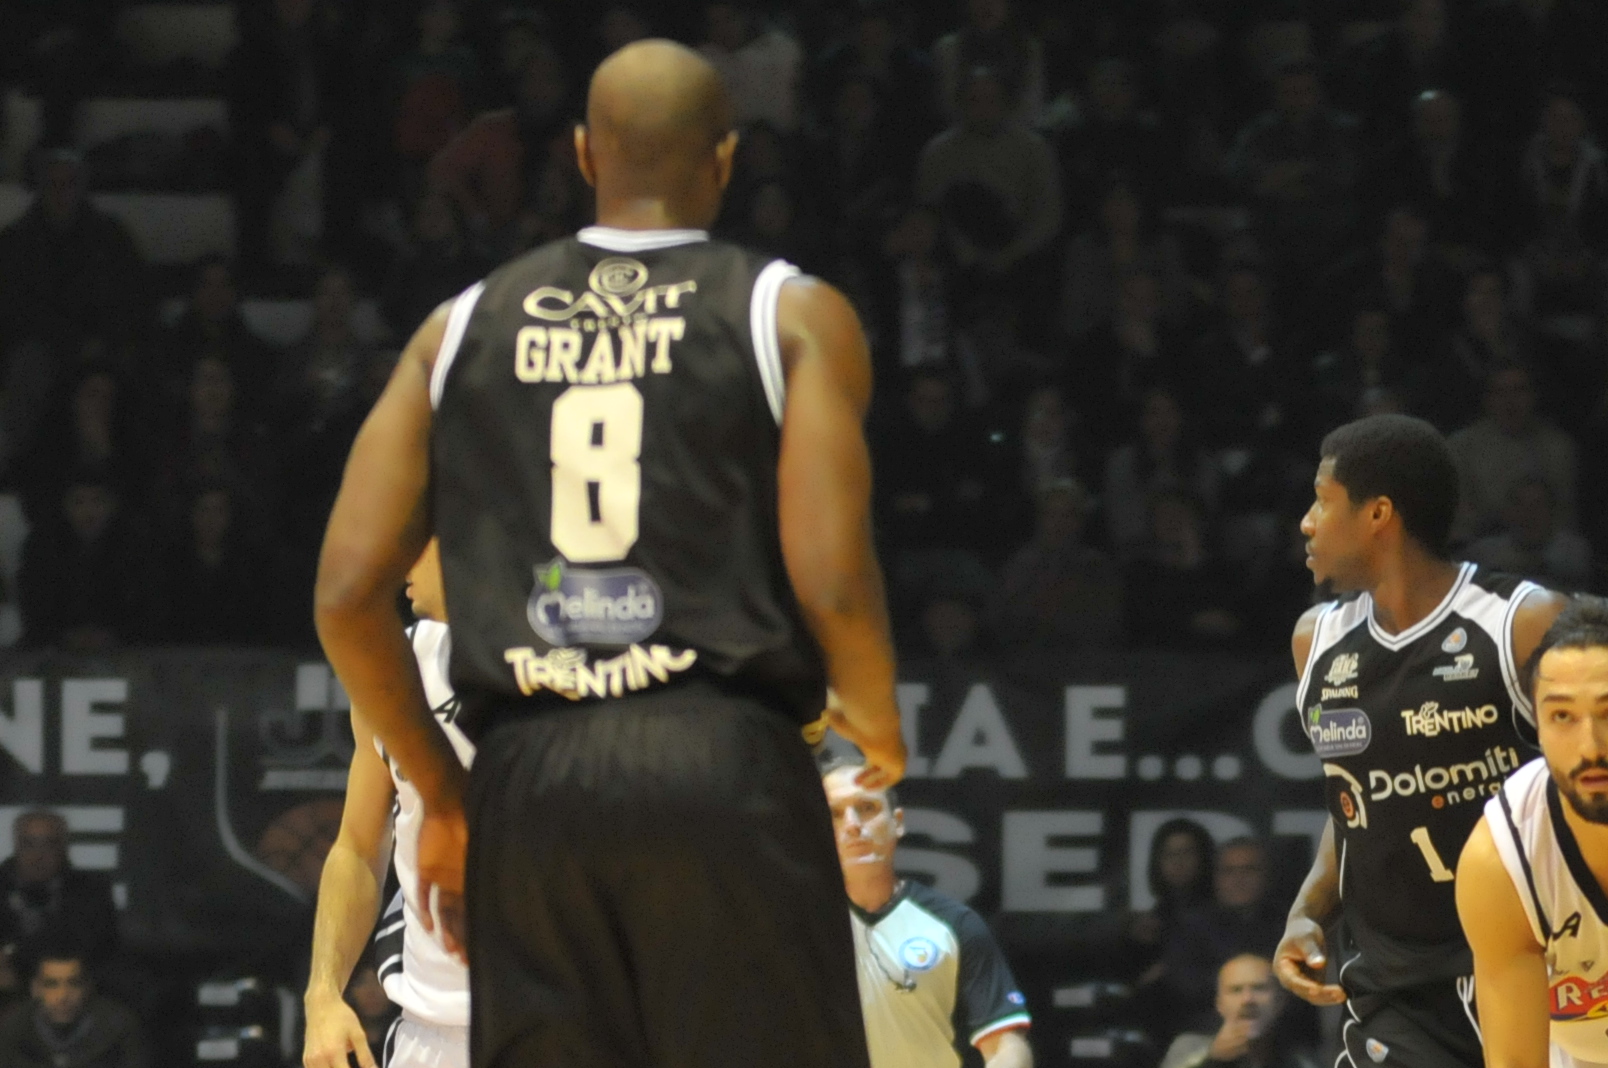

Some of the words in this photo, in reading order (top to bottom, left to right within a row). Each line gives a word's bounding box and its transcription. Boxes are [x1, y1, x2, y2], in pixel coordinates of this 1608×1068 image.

[515, 316, 686, 384] GRANT
[551, 383, 643, 562] 8
[1400, 703, 1498, 738] TRENTINO
[1369, 746, 1519, 801] Dolomiti
